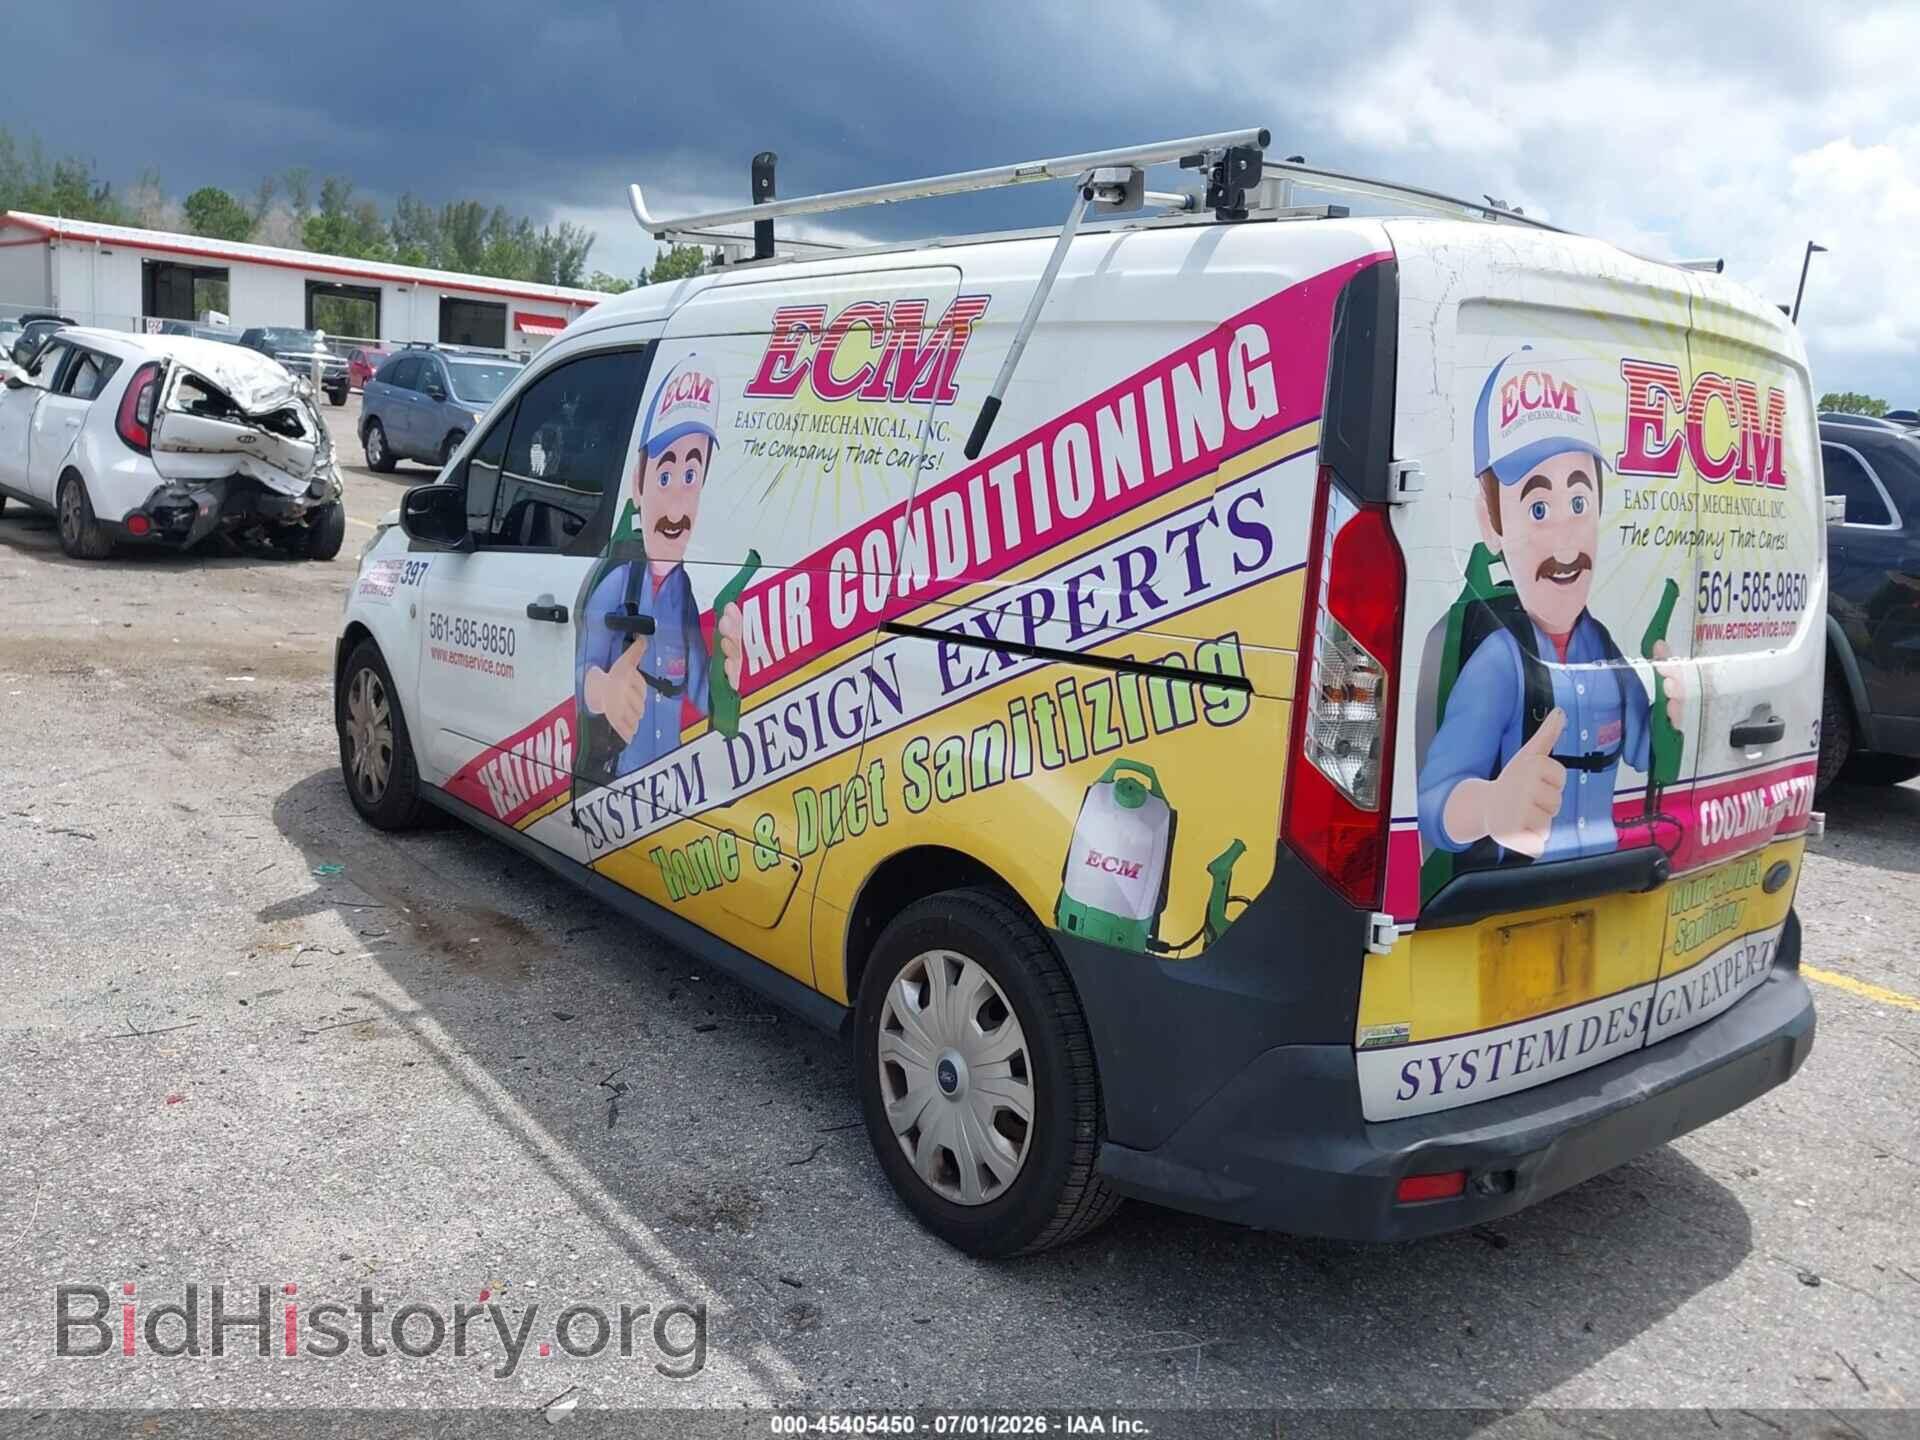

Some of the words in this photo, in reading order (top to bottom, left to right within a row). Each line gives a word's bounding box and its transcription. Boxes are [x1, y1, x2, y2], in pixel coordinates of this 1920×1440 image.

[743, 294, 992, 406] ECM
[660, 371, 714, 415] ECM
[1500, 370, 1581, 429] ECM
[734, 410, 769, 429] EAST
[766, 410, 810, 433] COAST
[807, 413, 912, 441] MECHANICAL,
[1616, 357, 1787, 490] ECM
[743, 437, 767, 457] The
[767, 439, 839, 473] Company
[846, 444, 882, 465] That
[885, 447, 945, 471] Cares!
[740, 572, 814, 676] AIR
[828, 323, 1281, 630] CONDITIONING
[1624, 488, 1657, 510] EAST
[1660, 490, 1700, 512] COAST
[1619, 521, 1649, 547] The
[1654, 525, 1725, 561] Company
[1730, 525, 1757, 549] That
[400, 560, 429, 587] 397
[1697, 571, 1807, 614] 561-585-9850
[430, 612, 515, 657] 561-585-9850
[1695, 617, 1798, 641] www.ecmservice.com
[576, 751, 708, 850] SYSTEM
[723, 652, 905, 790] DESIGN
[936, 487, 1276, 698] EXPERTS
[476, 717, 573, 819] HEATING
[649, 829, 740, 902] Home
[753, 813, 780, 872] &
[793, 758, 889, 858] Duct
[901, 631, 1252, 814] Sanitizing
[1085, 849, 1144, 880] ECM
[1395, 1022, 1572, 1102] SYSTEM
[1575, 980, 1697, 1056] DESIGN
[1699, 937, 1776, 1010] EXPERT
